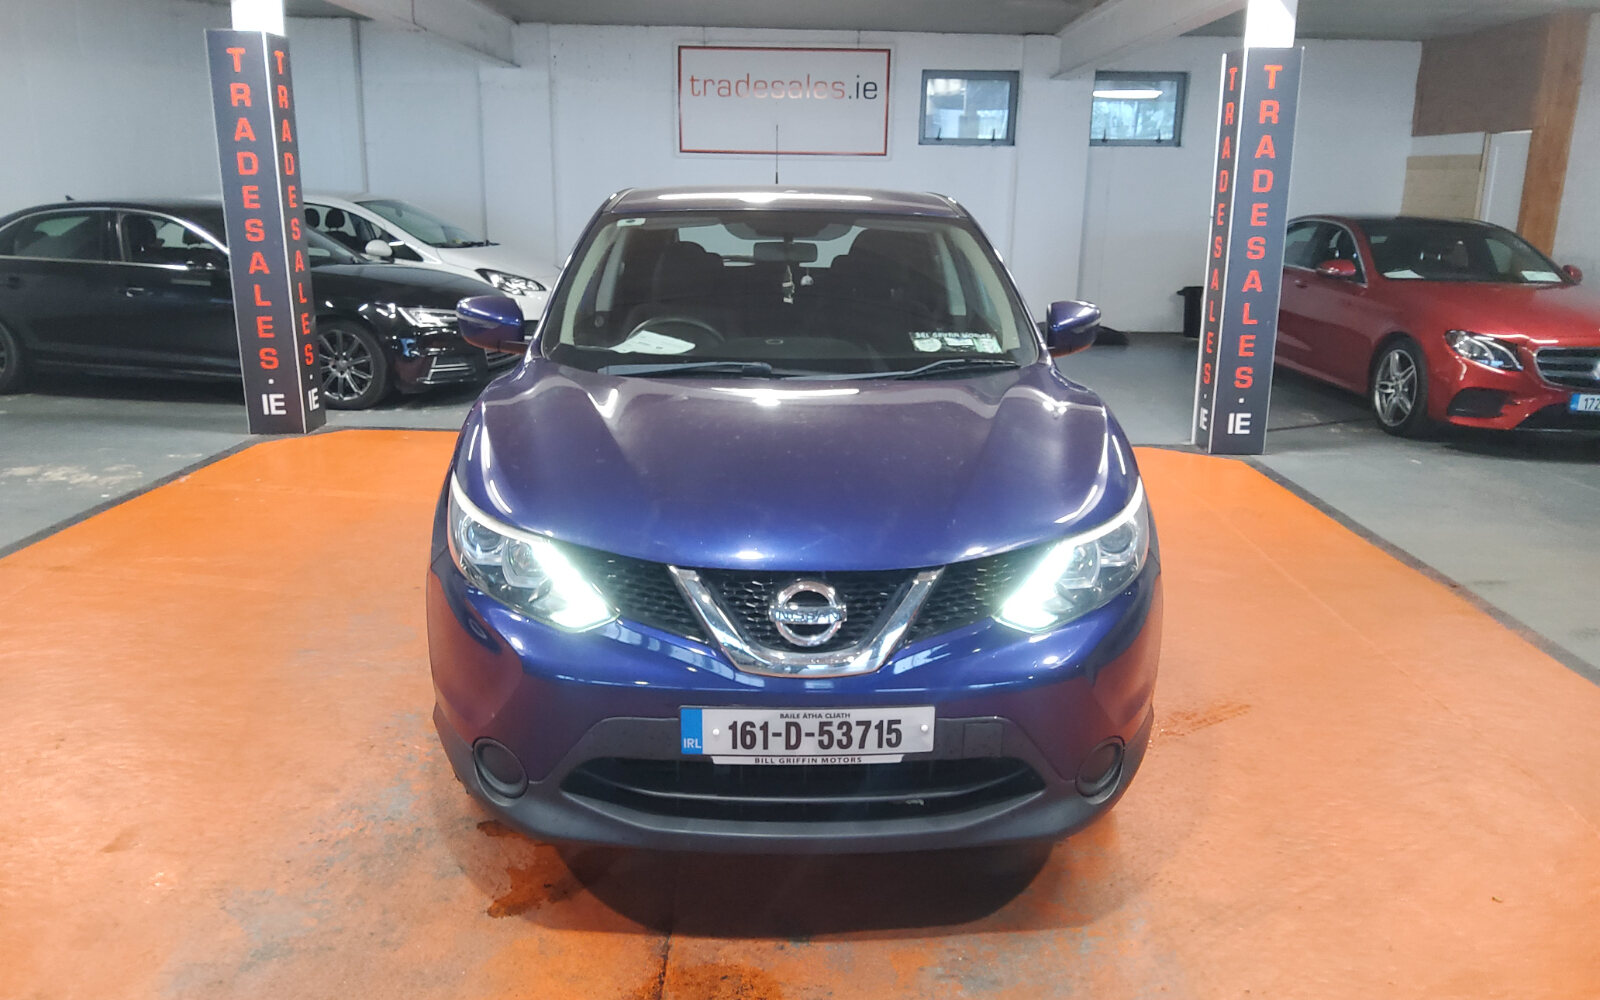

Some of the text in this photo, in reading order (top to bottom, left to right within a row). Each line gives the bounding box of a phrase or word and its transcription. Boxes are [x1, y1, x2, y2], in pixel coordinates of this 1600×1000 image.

[689, 72, 878, 100] tradesales.ie
[683, 737, 702, 749] IRL
[728, 719, 903, 751] 161-D-53715
